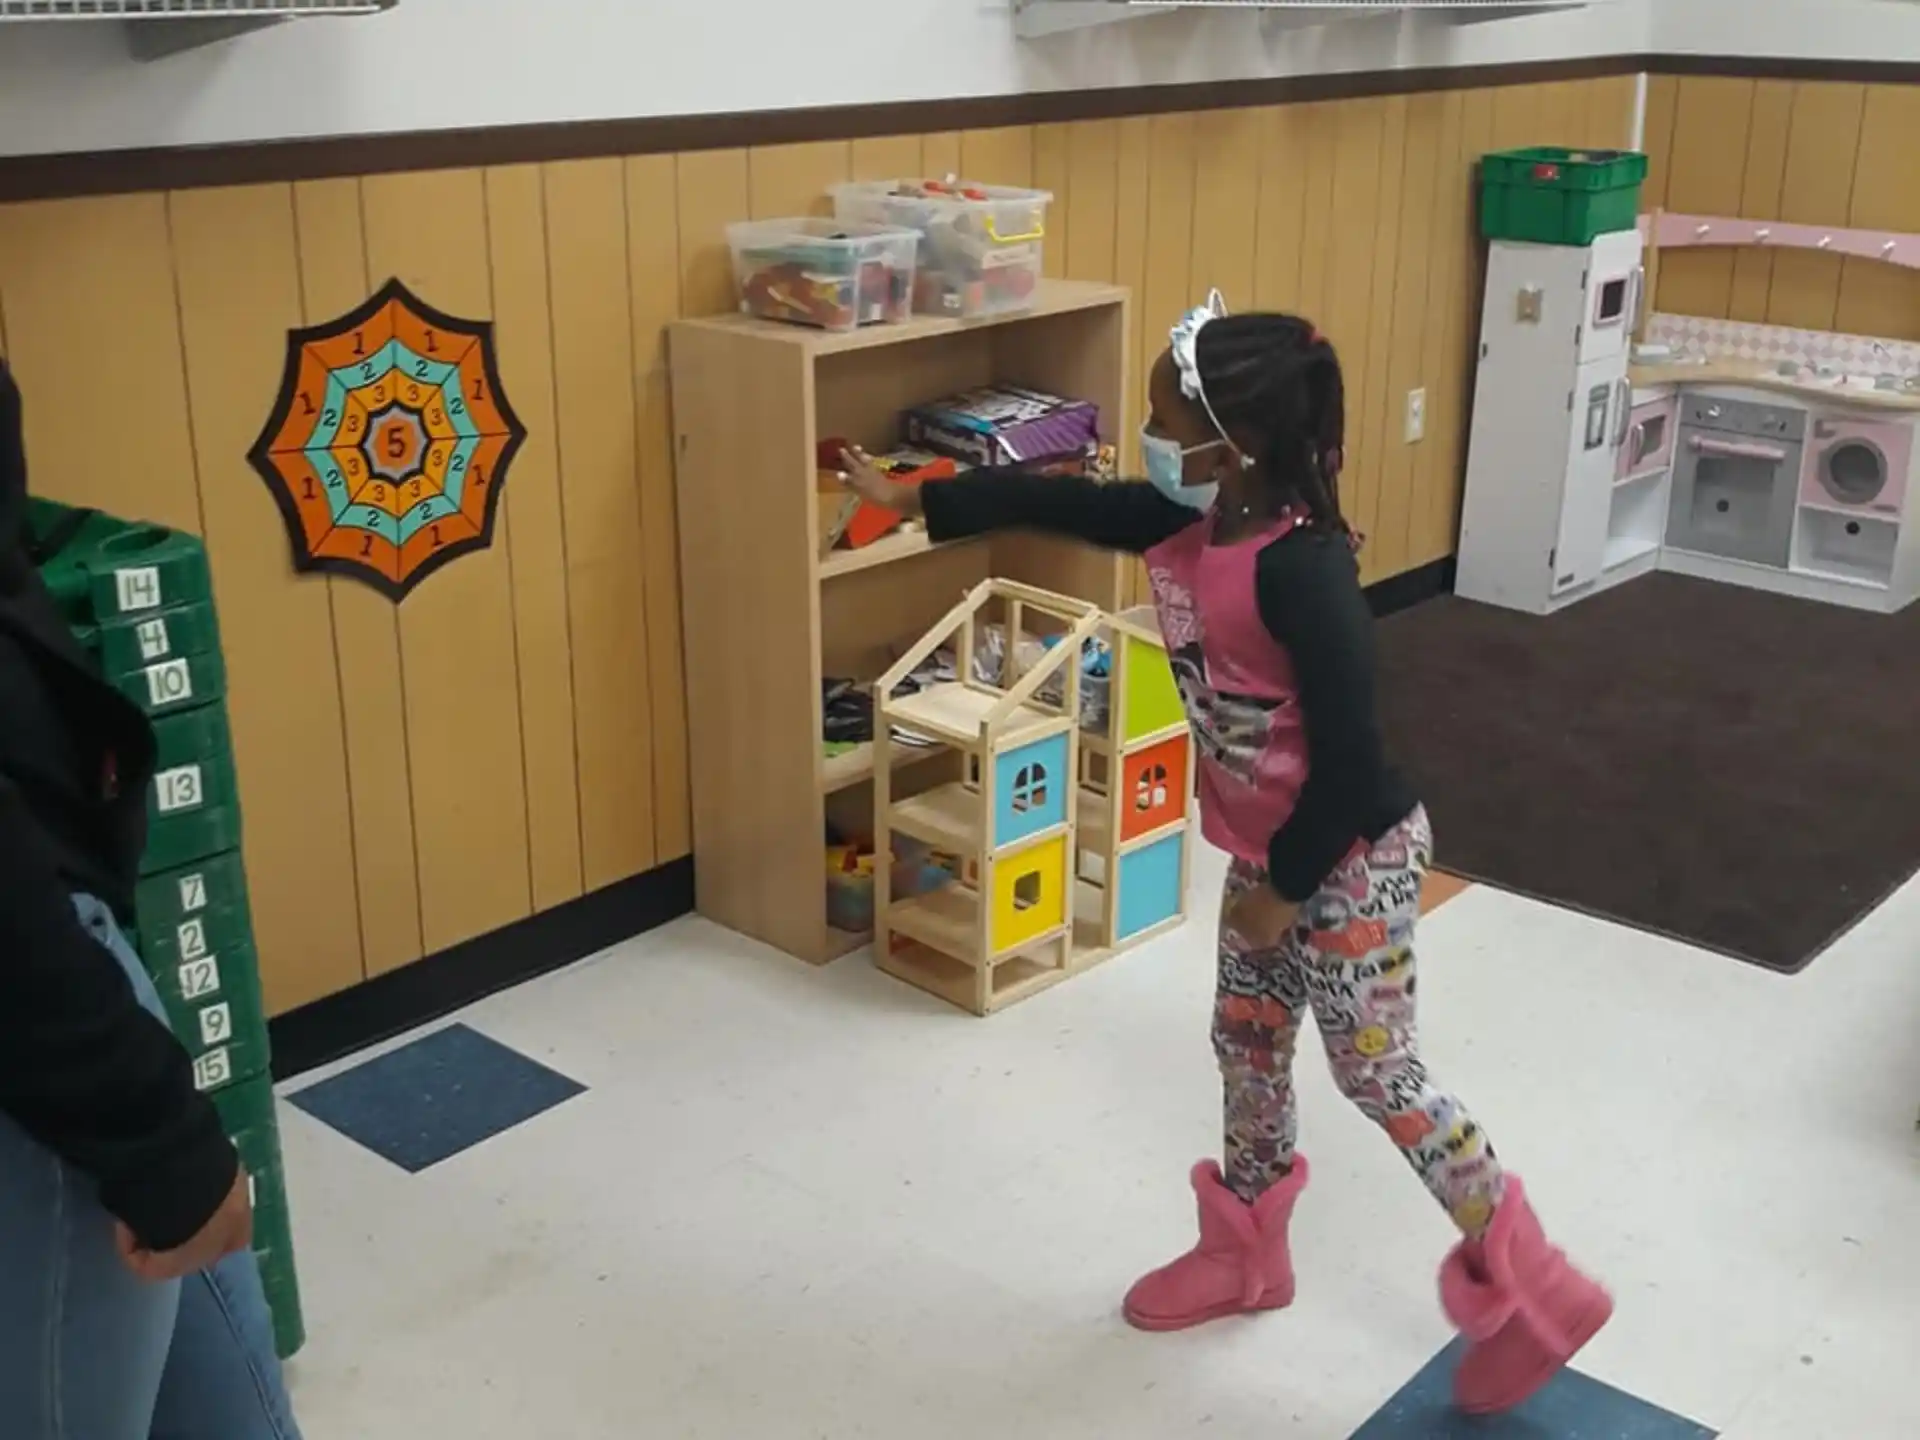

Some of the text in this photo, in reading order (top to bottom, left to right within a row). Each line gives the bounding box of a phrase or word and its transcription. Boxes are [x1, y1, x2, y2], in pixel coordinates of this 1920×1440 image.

[353, 332, 364, 354] 1
[424, 331, 439, 352] 1
[361, 362, 377, 380] 2
[416, 360, 429, 377] 2
[374, 386, 385, 401] 3
[408, 384, 419, 401] 3
[473, 380, 484, 400] 1
[299, 392, 316, 415] 1
[451, 398, 464, 414] 2
[323, 409, 336, 427] 2
[347, 415, 359, 432] 3
[431, 408, 442, 425] 3
[388, 427, 405, 458] 5
[347, 458, 359, 476] 3
[432, 450, 442, 466] 3
[451, 455, 464, 472] 2
[326, 469, 342, 488] 2
[473, 465, 486, 486] 1
[302, 478, 316, 499] 1
[374, 485, 385, 501] 3
[410, 481, 421, 497] 3
[368, 510, 380, 527] 2
[420, 504, 433, 520] 2
[361, 535, 373, 556] 1
[431, 526, 443, 546] 1
[125, 573, 155, 604] 14
[143, 624, 163, 651] 4
[154, 667, 184, 699] 10
[167, 772, 195, 806] 13
[185, 878, 201, 906] 7
[182, 925, 201, 954] 2
[185, 962, 212, 995] 12
[206, 1010, 224, 1037] 9
[198, 1054, 224, 1083] 15
